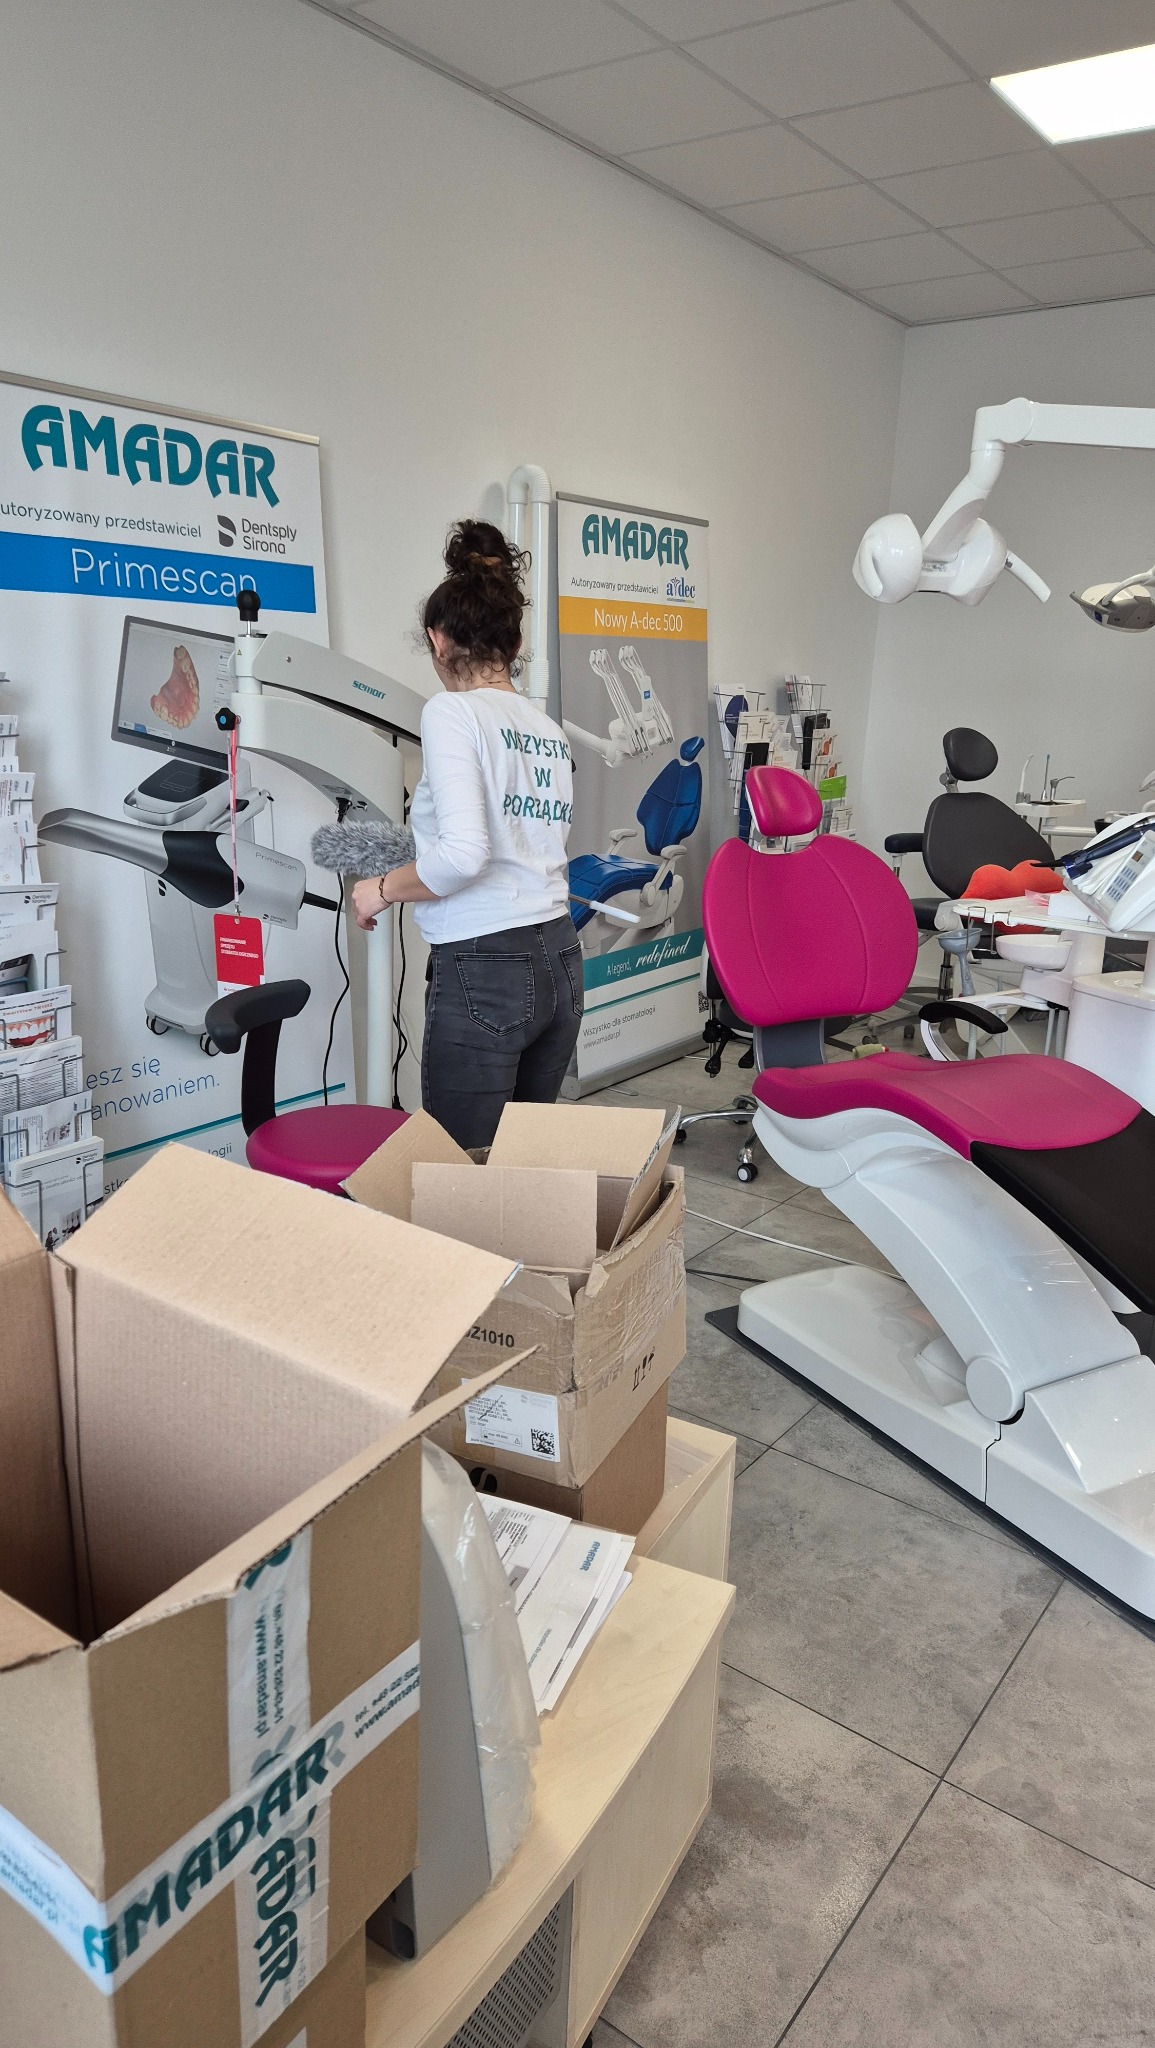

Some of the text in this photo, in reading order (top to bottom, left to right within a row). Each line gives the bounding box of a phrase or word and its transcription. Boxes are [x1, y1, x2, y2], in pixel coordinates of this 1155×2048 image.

[21, 404, 280, 507] AMADAR
[0, 502, 202, 538] utoryzowany przedstawiciel
[241, 518, 298, 542] Dentsply
[242, 536, 287, 555] Sirona
[581, 513, 690, 571] AMADAR
[71, 548, 257, 599] Primescan
[570, 576, 659, 595] Autoryzowany przedstawiciel
[594, 607, 683, 632] Nowy A-dec 500
[533, 766, 552, 788] W
[635, 935, 691, 968] redefined
[582, 1005, 656, 1037] Wszystko dla stomatologii
[85, 1067, 123, 1090] esz
[131, 1056, 161, 1079] się
[91, 1073, 220, 1121] anowaniem.
[83, 1737, 329, 1975] AMADAR
[250, 1837, 298, 2007] ADAR
